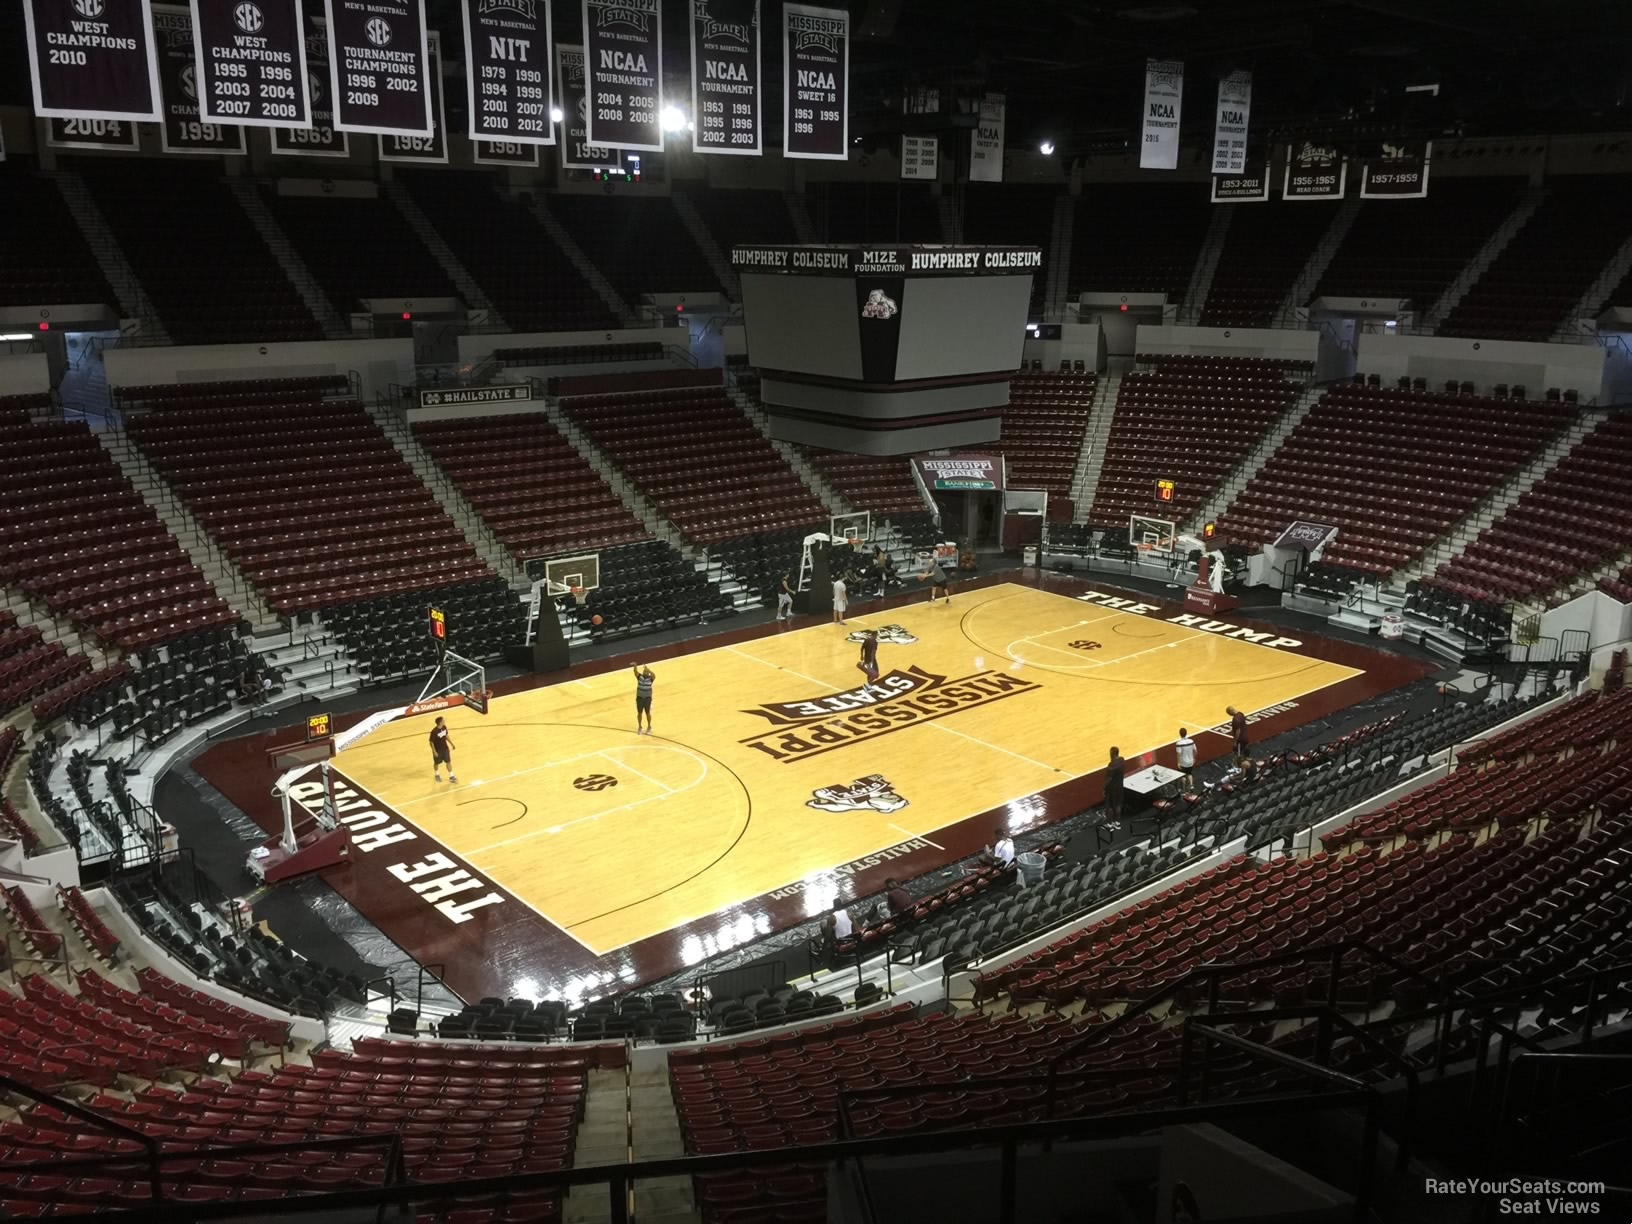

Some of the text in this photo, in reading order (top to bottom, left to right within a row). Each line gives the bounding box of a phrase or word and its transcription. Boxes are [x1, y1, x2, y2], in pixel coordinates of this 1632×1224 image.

[75, 0, 103, 17] SEC
[345, 2, 408, 16] MEN'S BASKETBALL
[490, 0, 525, 11] STATE
[235, 3, 262, 32] SEC
[480, 18, 536, 30] MEN'S BASKETBALL
[607, 9, 639, 24] STATE
[71, 21, 109, 34] WEST
[367, 19, 390, 45] SEC
[712, 24, 740, 36] STATE
[788, 15, 845, 34] MISSISSIPPI
[47, 33, 136, 50] CHAMPIONS
[234, 36, 267, 48] WEST
[599, 32, 648, 43] MEN'S BASKETBALL
[804, 34, 829, 46] STATE
[212, 47, 291, 63] CHAMPIONS
[344, 46, 416, 63] TOURNAMENT
[490, 36, 530, 62] NIT
[720, 45, 748, 53] BASKETBALL
[49, 50, 86, 65] 2010
[600, 50, 648, 72] NCAA
[214, 63, 292, 81] 1995 1996
[346, 59, 416, 75] CHAMPIONS
[482, 66, 541, 83] 1979 1990
[705, 60, 748, 81] NCAA
[348, 74, 417, 92] 1996 2002
[596, 72, 654, 87] TOURNAMENT
[797, 70, 836, 90] NCAA
[215, 81, 250, 96] 2003
[260, 85, 295, 99] 2004
[482, 83, 542, 99] 1994 1999
[701, 82, 753, 95] TOURNAMENT
[348, 92, 379, 106] 2009
[598, 93, 654, 108] 2004 2005
[798, 91, 836, 103] SWEET 16
[216, 100, 250, 114] 2007
[262, 103, 296, 117] 2008
[483, 100, 543, 115] 2001 2007
[703, 101, 751, 115] 1963 1991
[795, 108, 840, 121] 1963 1995
[1150, 103, 1175, 118] NCAA
[483, 116, 543, 131] 2010 2012
[599, 109, 654, 123] 2008 2009
[703, 116, 752, 129] 1995 1996
[1221, 111, 1243, 124] NCAA
[63, 118, 121, 137] 2004
[179, 121, 223, 141] 1991
[794, 122, 813, 133] 1996
[1146, 120, 1178, 128] TOURNAMENT
[290, 128, 333, 144] 1963
[703, 131, 753, 144] 2002 2003
[976, 128, 999, 140] NCAA
[1222, 179, 1259, 189] 1953-2011
[1293, 176, 1336, 186] 1956-1965
[1371, 173, 1418, 184] 1957-1959
[732, 250, 849, 269] HUMPHREY COLISEUM
[863, 251, 897, 264] MIZE
[911, 251, 1042, 270] HUMPHREY COLISEUM
[854, 264, 905, 273] FOUNDATION
[444, 390, 511, 402] #HAILSTATE
[923, 461, 993, 470] MISSISSIPPI
[1076, 591, 1303, 647] THE HUMP
[783, 676, 915, 716] STATE
[747, 673, 1033, 759] MISSISSIPPI
[1212, 701, 1300, 734] #HAILSTTE
[315, 725, 326, 735] 10
[370, 718, 388, 734] STATE
[288, 781, 506, 924] THE HUMP
